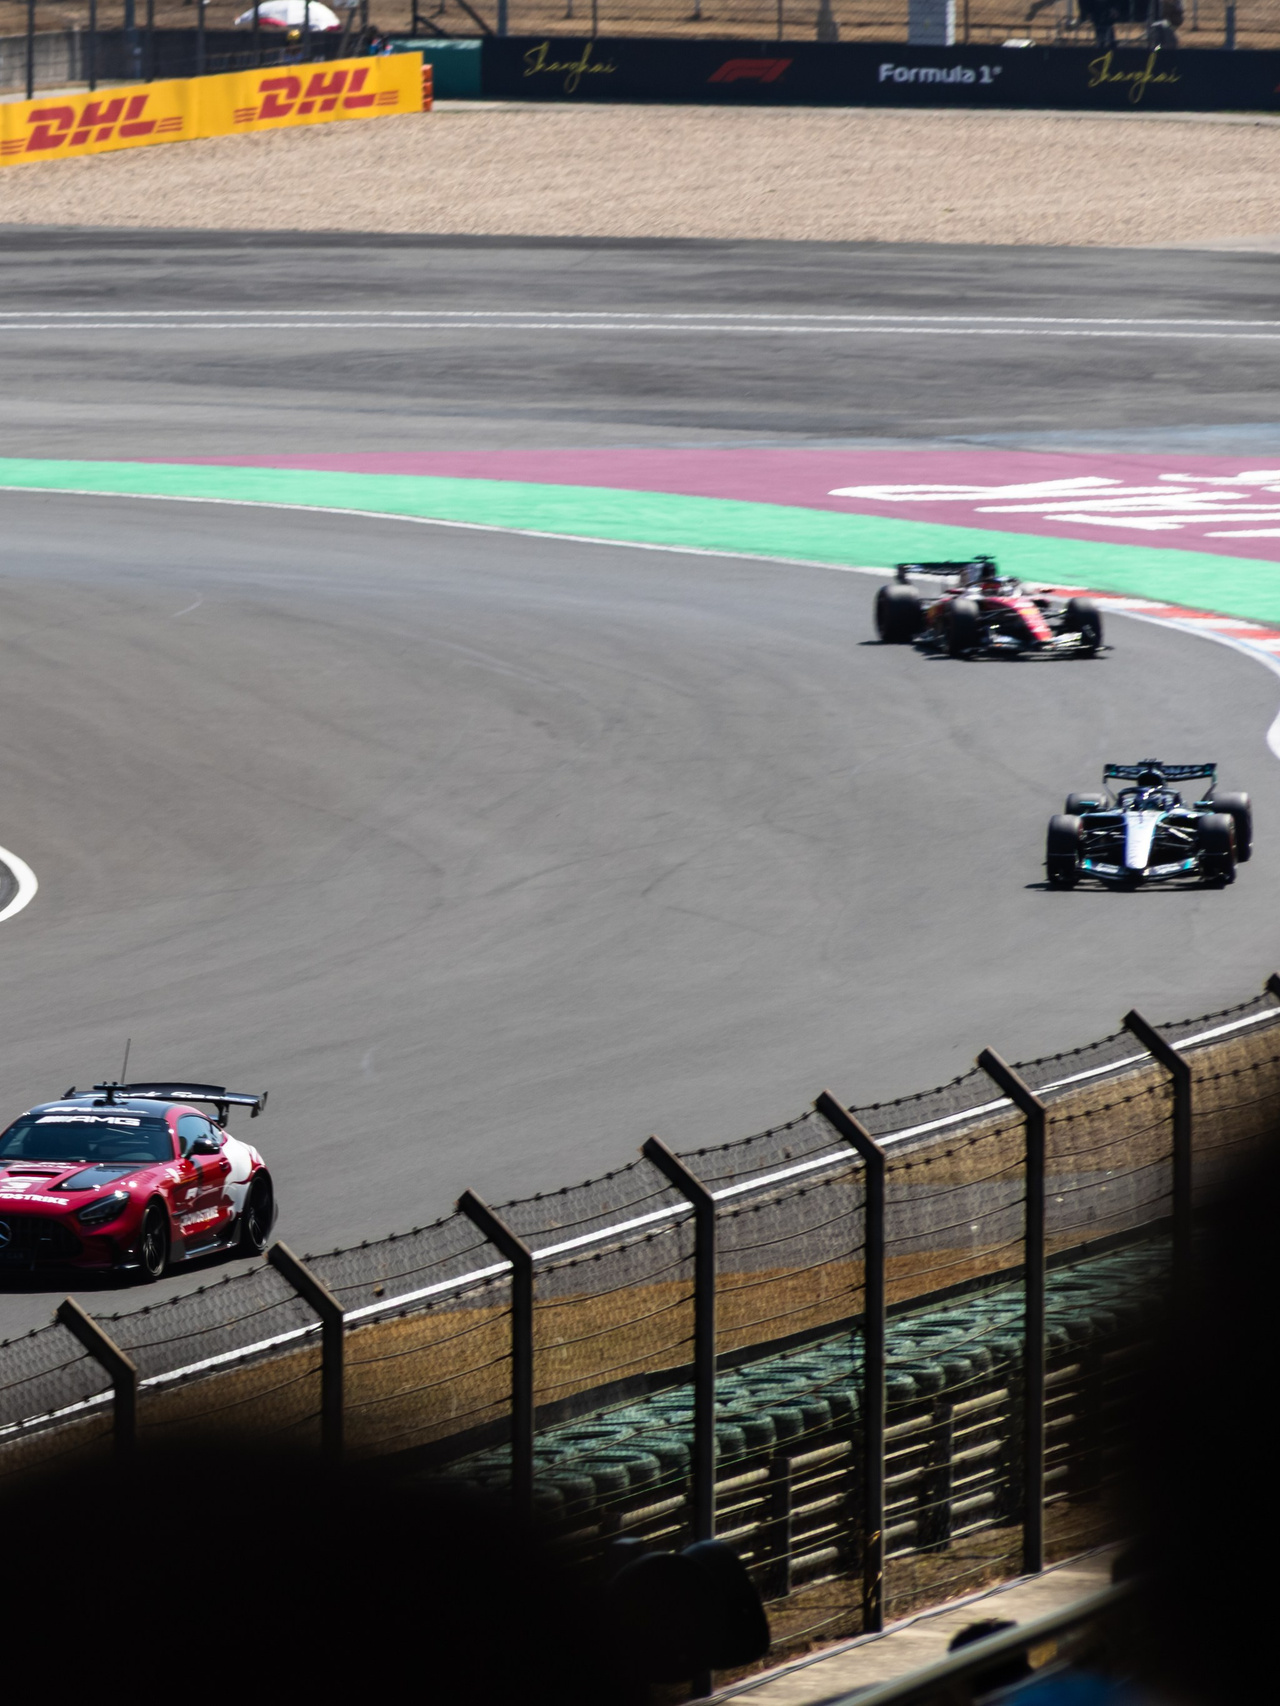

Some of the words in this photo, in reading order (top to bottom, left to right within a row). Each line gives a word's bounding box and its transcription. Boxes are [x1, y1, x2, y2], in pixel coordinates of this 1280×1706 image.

[258, 67, 376, 119] DHL
[523, 41, 617, 93] Shanghai
[879, 63, 975, 83] Formula
[1088, 50, 1181, 103] Shanghai
[26, 95, 157, 151] DHL
